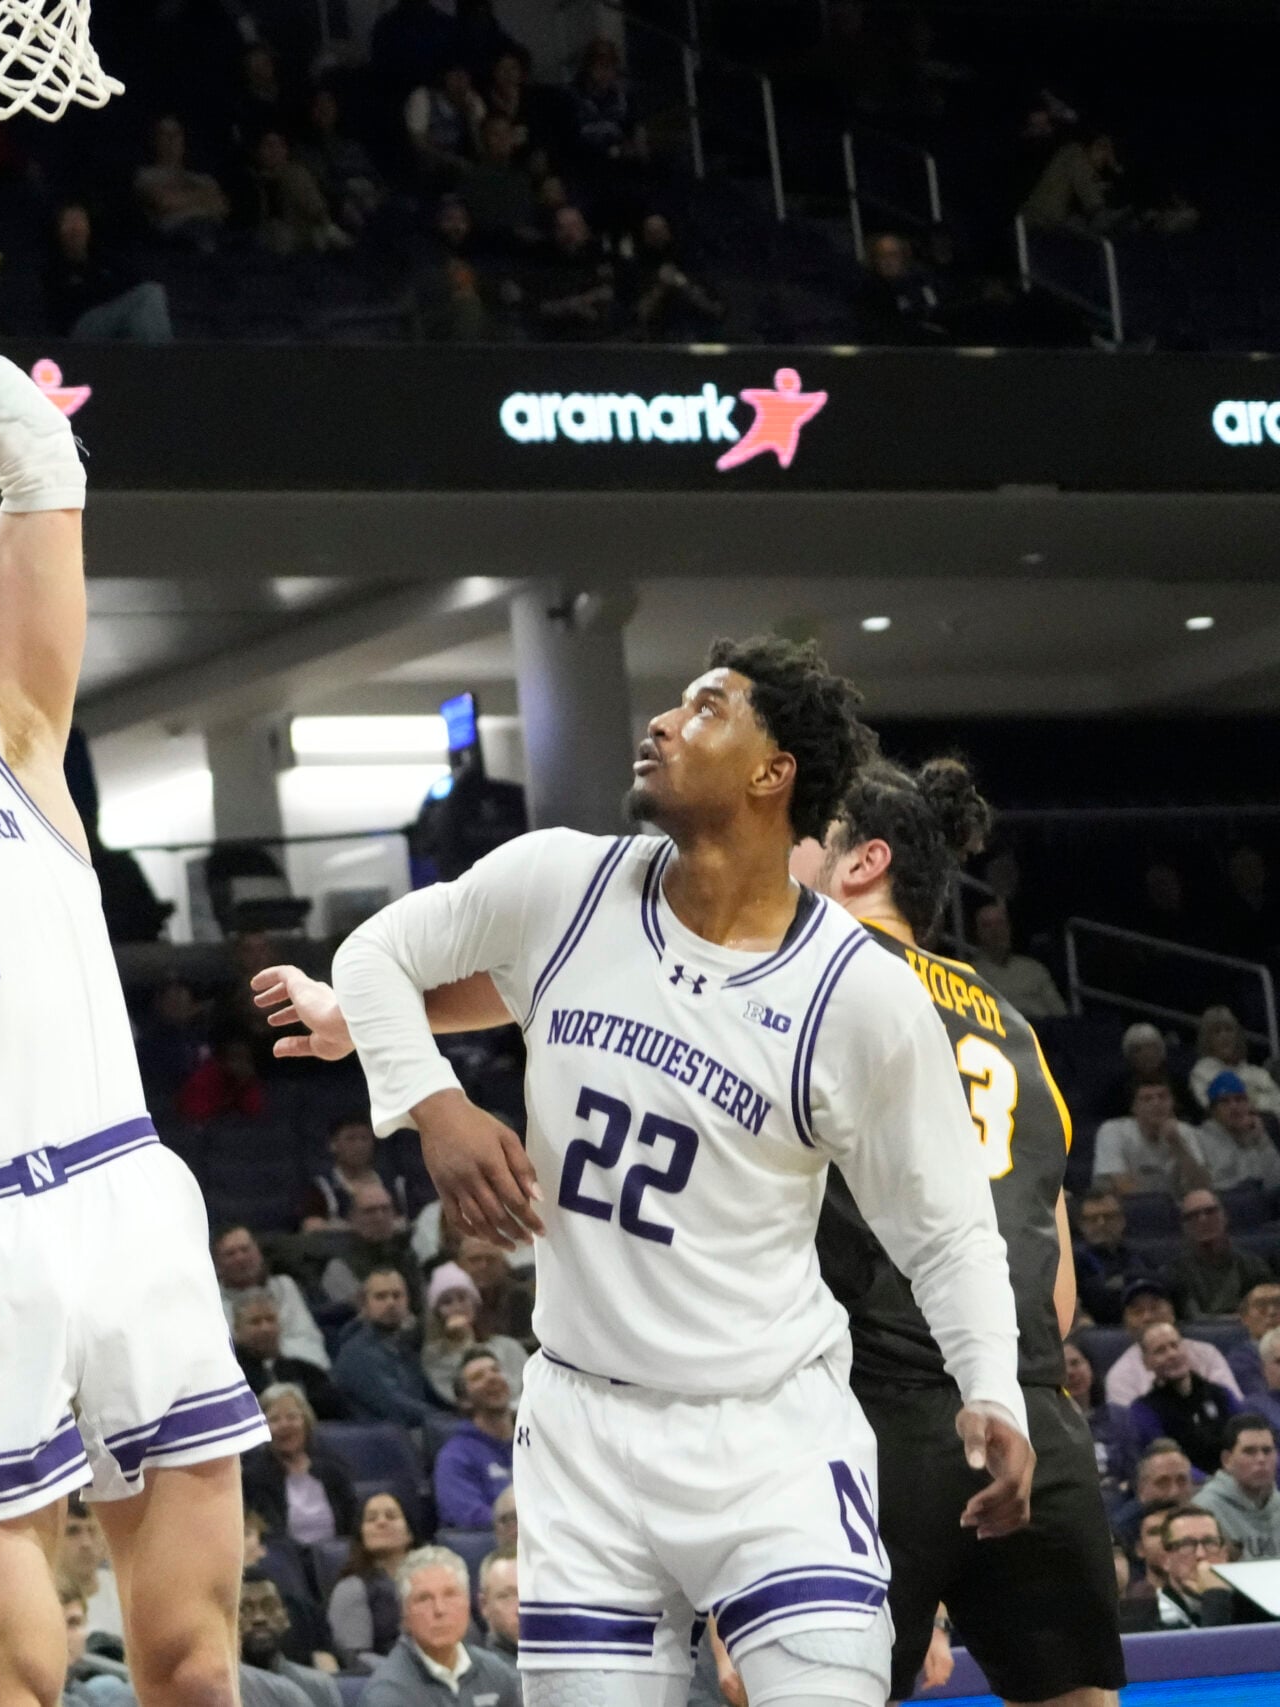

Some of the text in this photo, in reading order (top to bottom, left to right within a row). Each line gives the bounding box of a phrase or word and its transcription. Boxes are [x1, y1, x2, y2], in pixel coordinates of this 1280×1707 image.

[500, 383, 740, 441] aramark
[905, 949, 1006, 1038] HOPOI
[547, 1009, 772, 1136] NORTHWESTERN
[943, 1025, 1018, 1180] 3
[26, 1149, 55, 1188] N
[558, 1086, 699, 1246] 22
